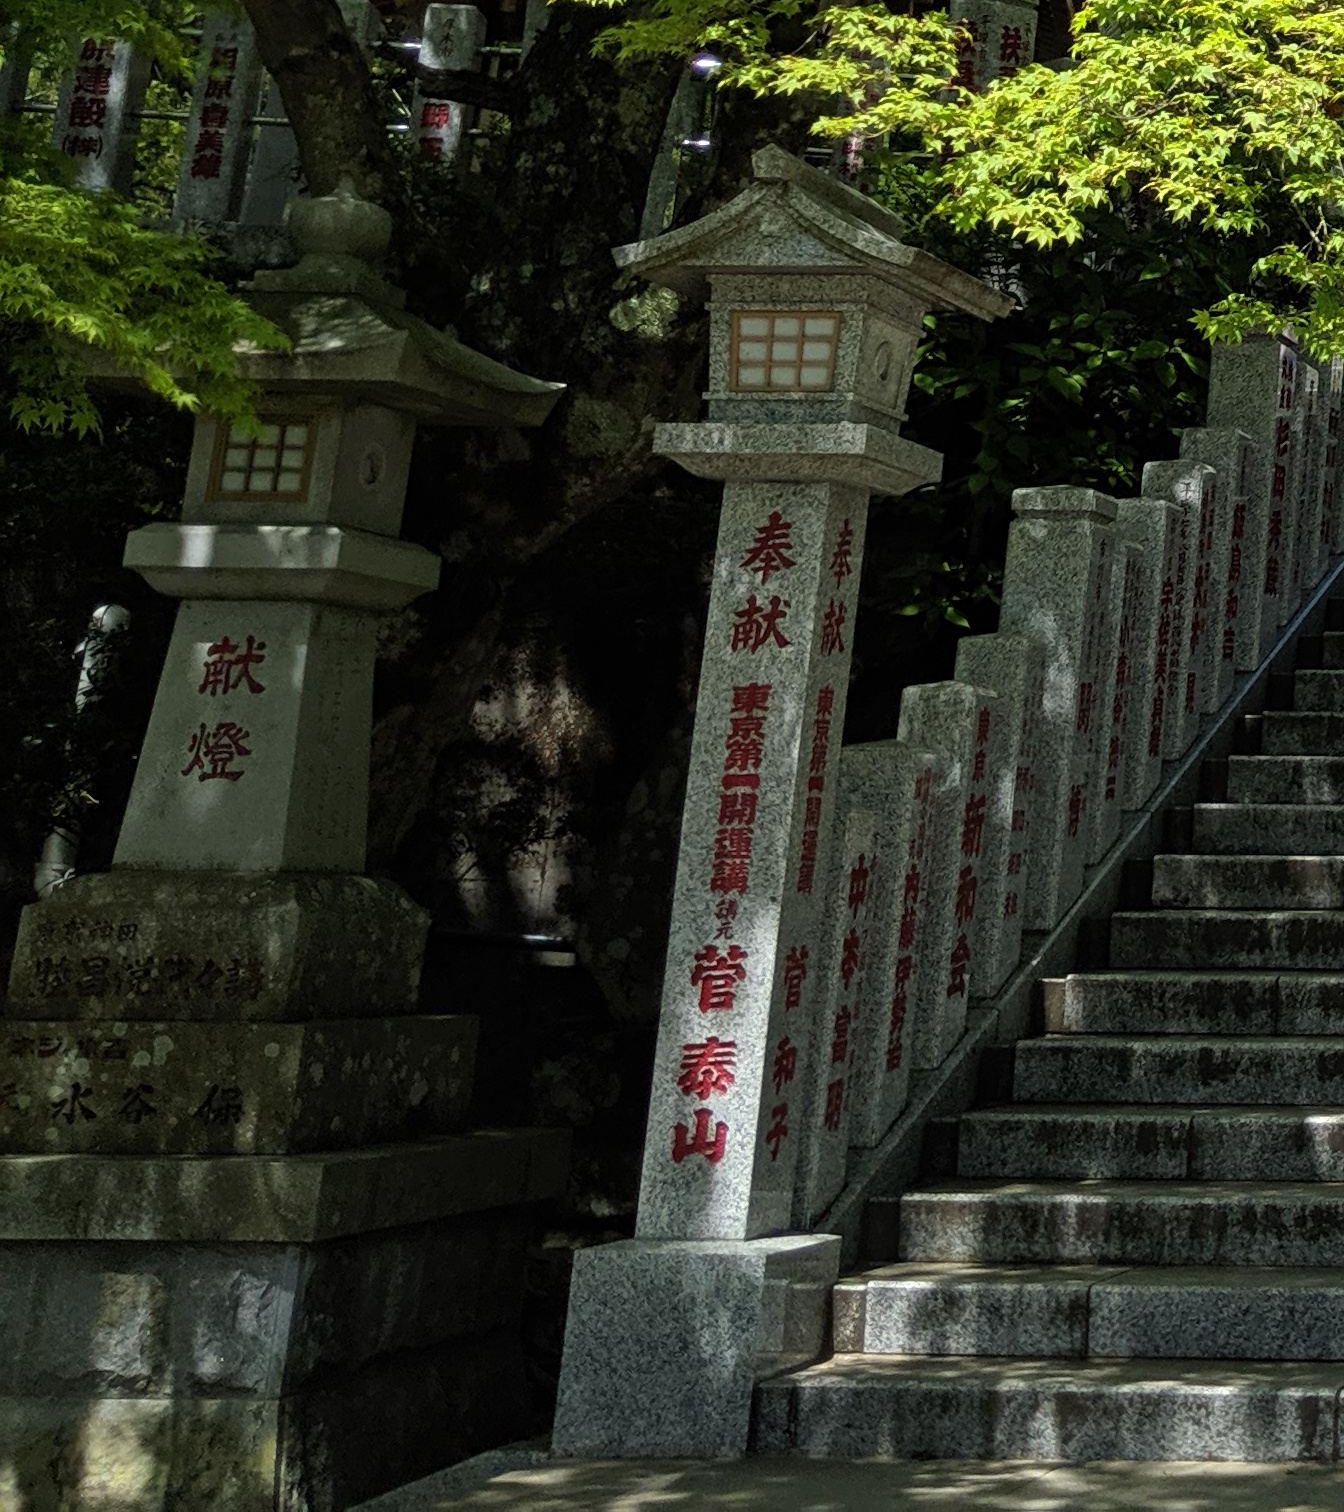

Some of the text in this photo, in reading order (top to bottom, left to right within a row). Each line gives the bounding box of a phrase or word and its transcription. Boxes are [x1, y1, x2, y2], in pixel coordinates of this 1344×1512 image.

[731, 510, 798, 655] 奉献
[819, 517, 854, 657] 奉献
[181, 634, 267, 783] 献燈
[710, 682, 773, 896] 東京第一開運講
[796, 685, 835, 895] 東京第一開運講
[671, 944, 749, 1164] 菅泰山
